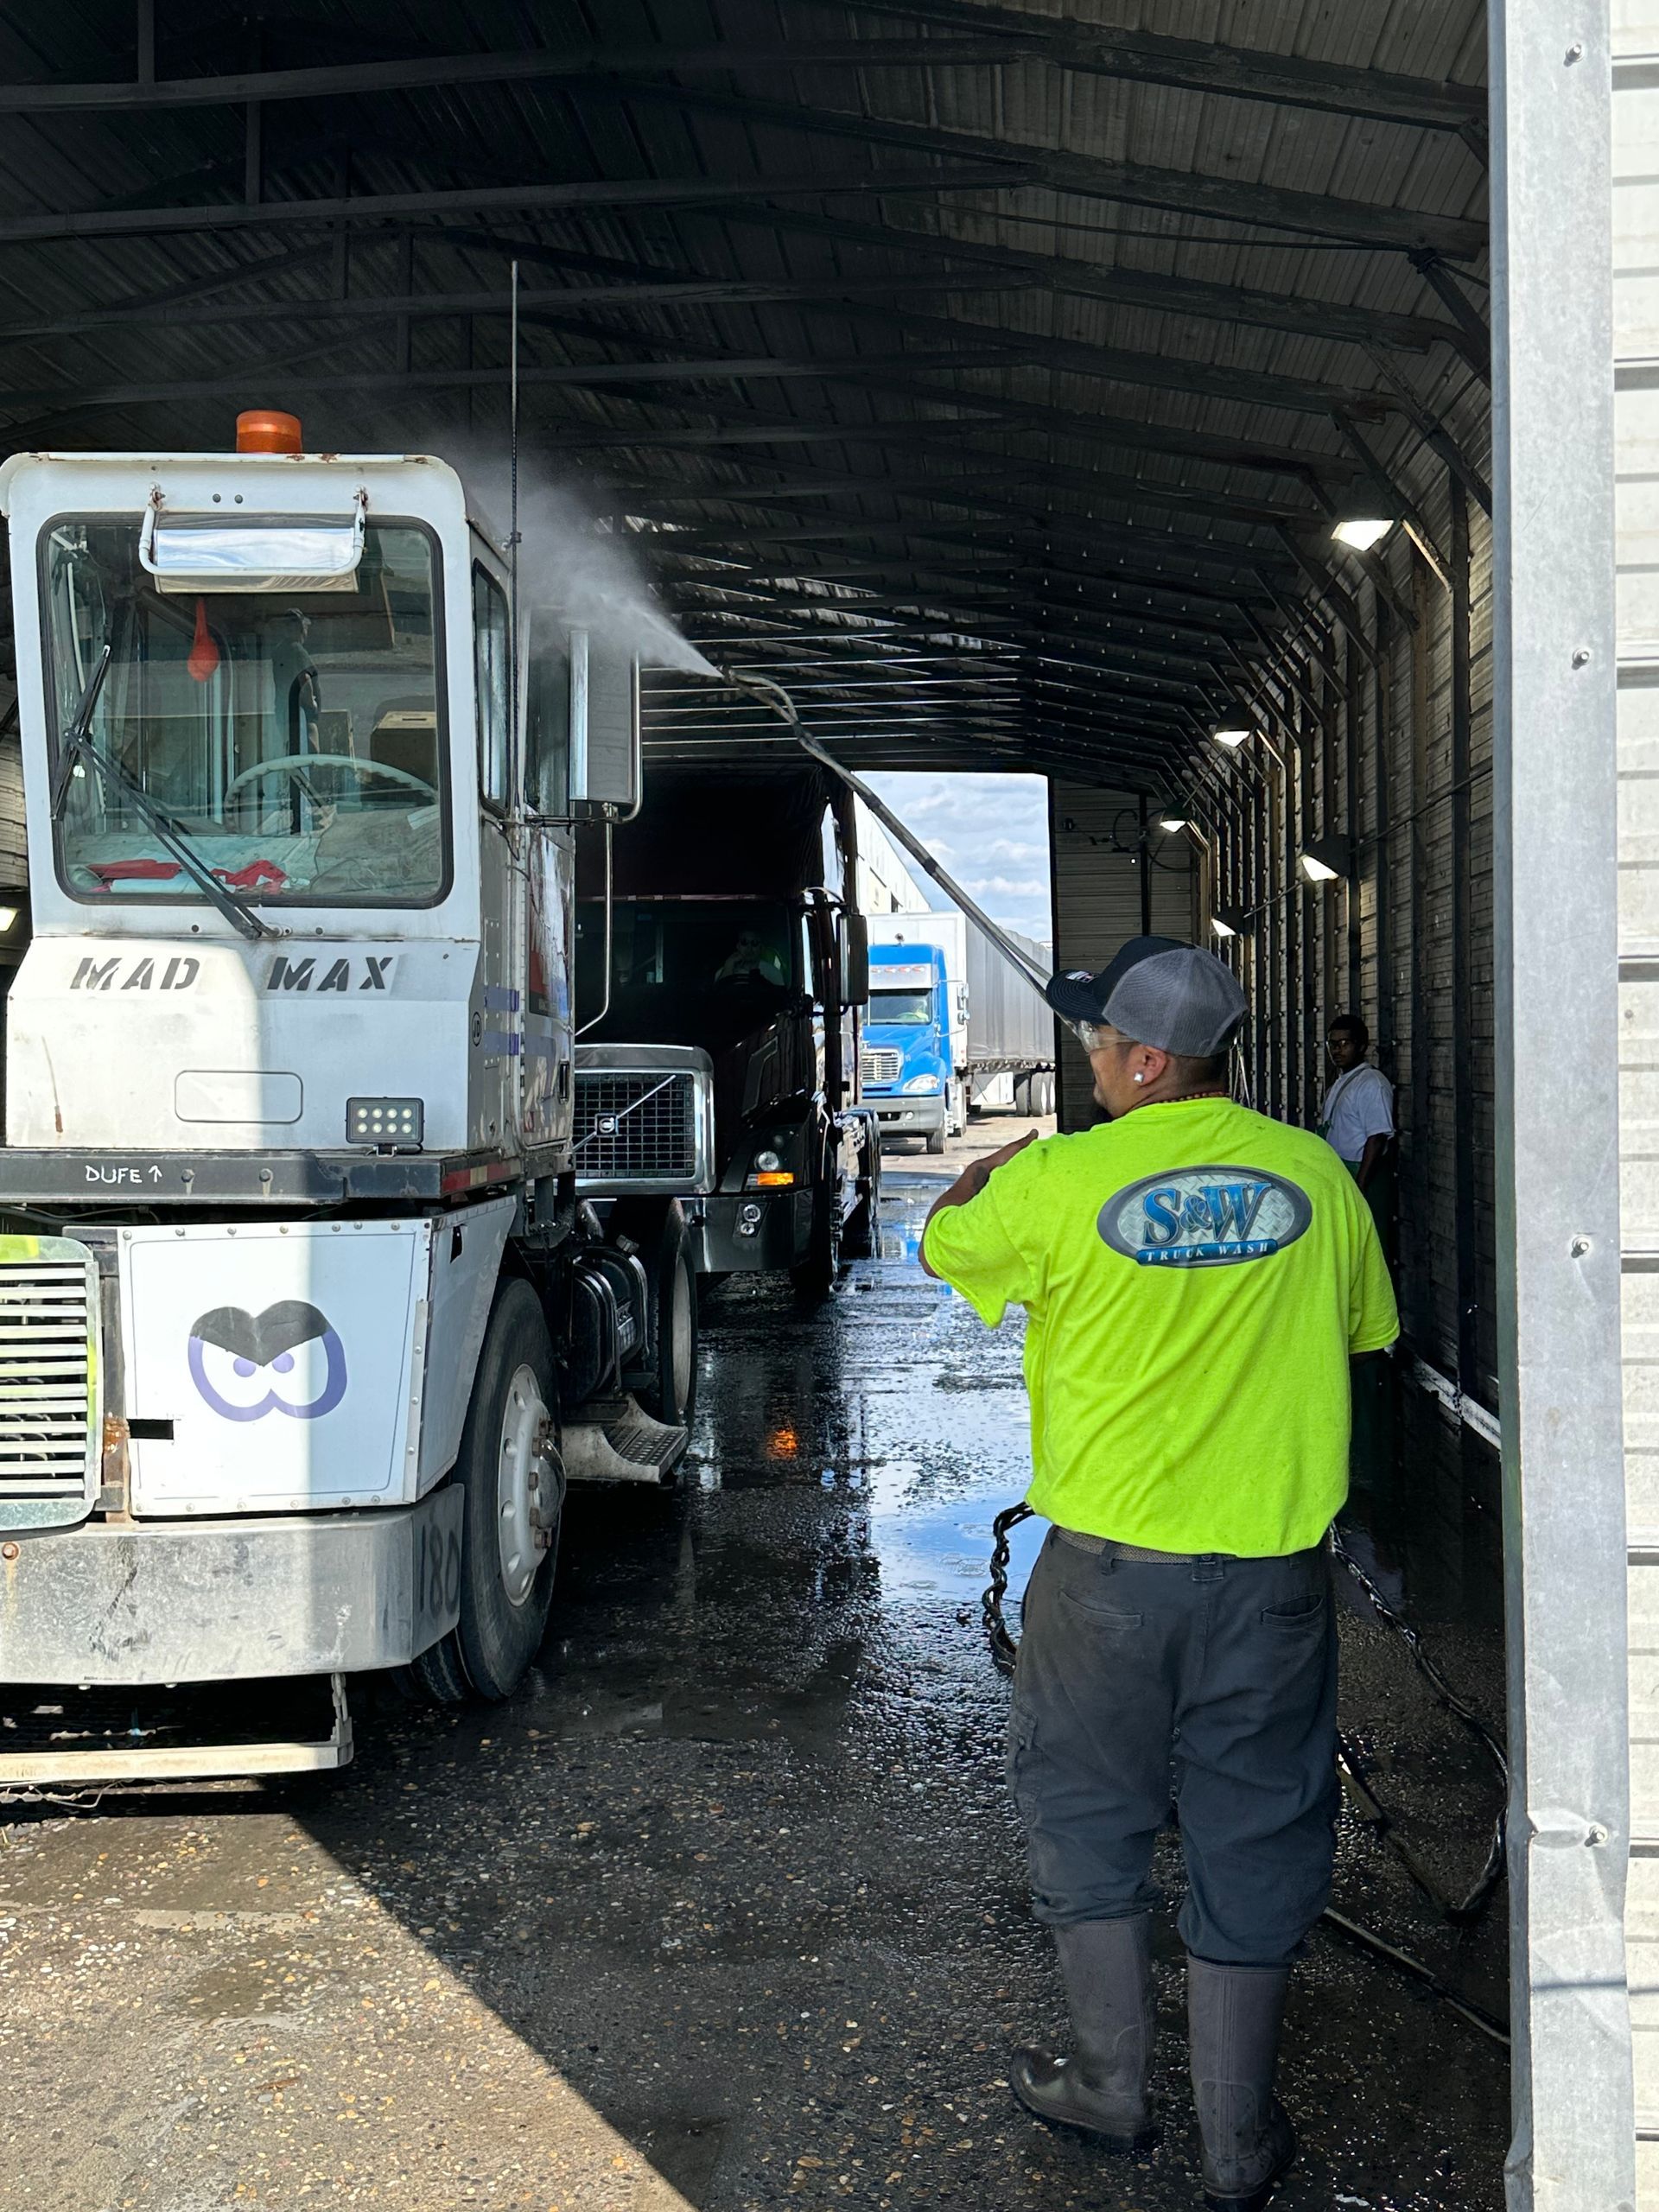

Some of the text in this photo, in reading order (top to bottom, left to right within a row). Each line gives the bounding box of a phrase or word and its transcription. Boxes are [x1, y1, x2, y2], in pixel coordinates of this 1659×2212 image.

[69, 957, 394, 992] MAD MAX
[1142, 1182, 1274, 1247] S&W
[1146, 1242, 1269, 1262] TRUCK WASH
[418, 1522, 461, 1618] 180
